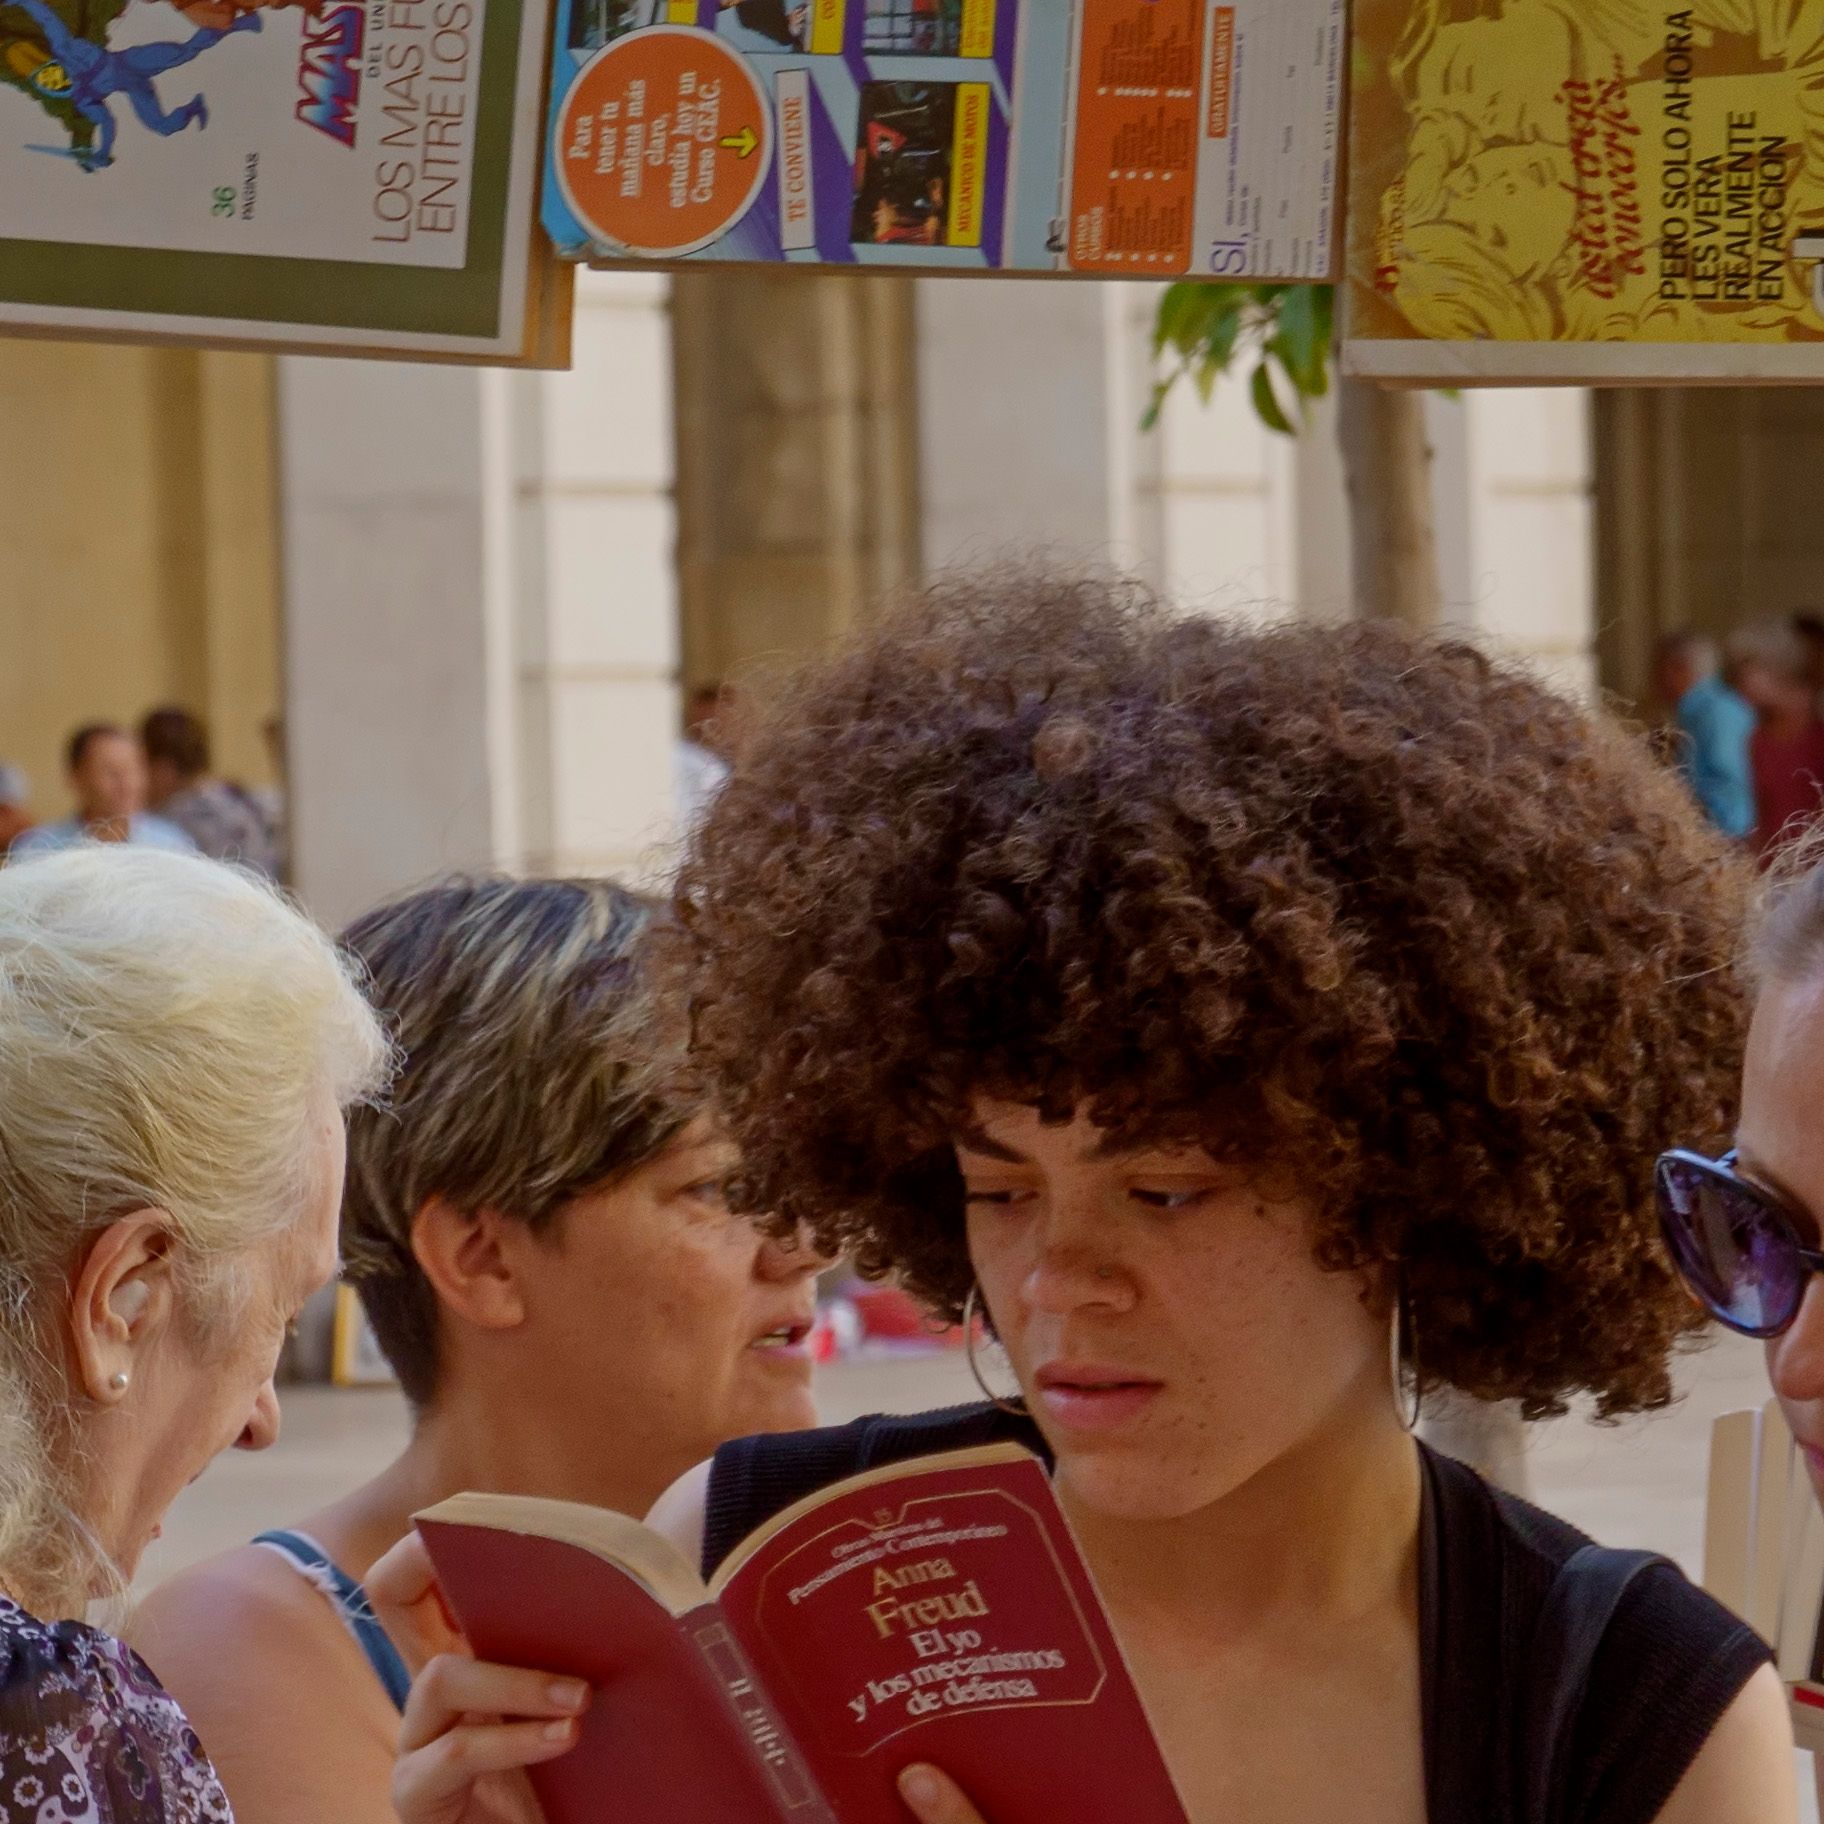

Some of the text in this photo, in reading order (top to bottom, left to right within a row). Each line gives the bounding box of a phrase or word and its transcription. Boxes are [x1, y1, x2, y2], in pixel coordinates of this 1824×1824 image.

[368, 0, 387, 32] UN
[293, 0, 365, 151] MAS
[378, 43, 425, 149] MAS
[1209, 14, 1232, 133] GRATUITAMENTE
[416, 1, 473, 233] ENTRE LOS
[568, 115, 593, 159] Para
[594, 101, 620, 175] tener tu
[667, 70, 697, 208] estudia hoy un
[1658, 9, 1695, 301] PERO SOLO AHORA
[240, 152, 259, 220] PAGINAS
[617, 123, 646, 198] mañana
[689, 148, 716, 203] Curso
[783, 96, 806, 223] TE CONVIENE
[208, 185, 237, 219] 36
[371, 159, 416, 243] LOS
[1690, 153, 1722, 302] LES VERA
[1723, 110, 1757, 302] REALMENTE
[1757, 134, 1788, 301] EN ACCION
[787, 1546, 887, 1606] Pensamiento
[863, 1579, 990, 1640] Freud
[873, 1557, 957, 1597] Anna
[908, 1628, 982, 1659] El yo
[846, 1646, 1067, 1723] y los mecanismos
[906, 1675, 1039, 1716] de defensa
